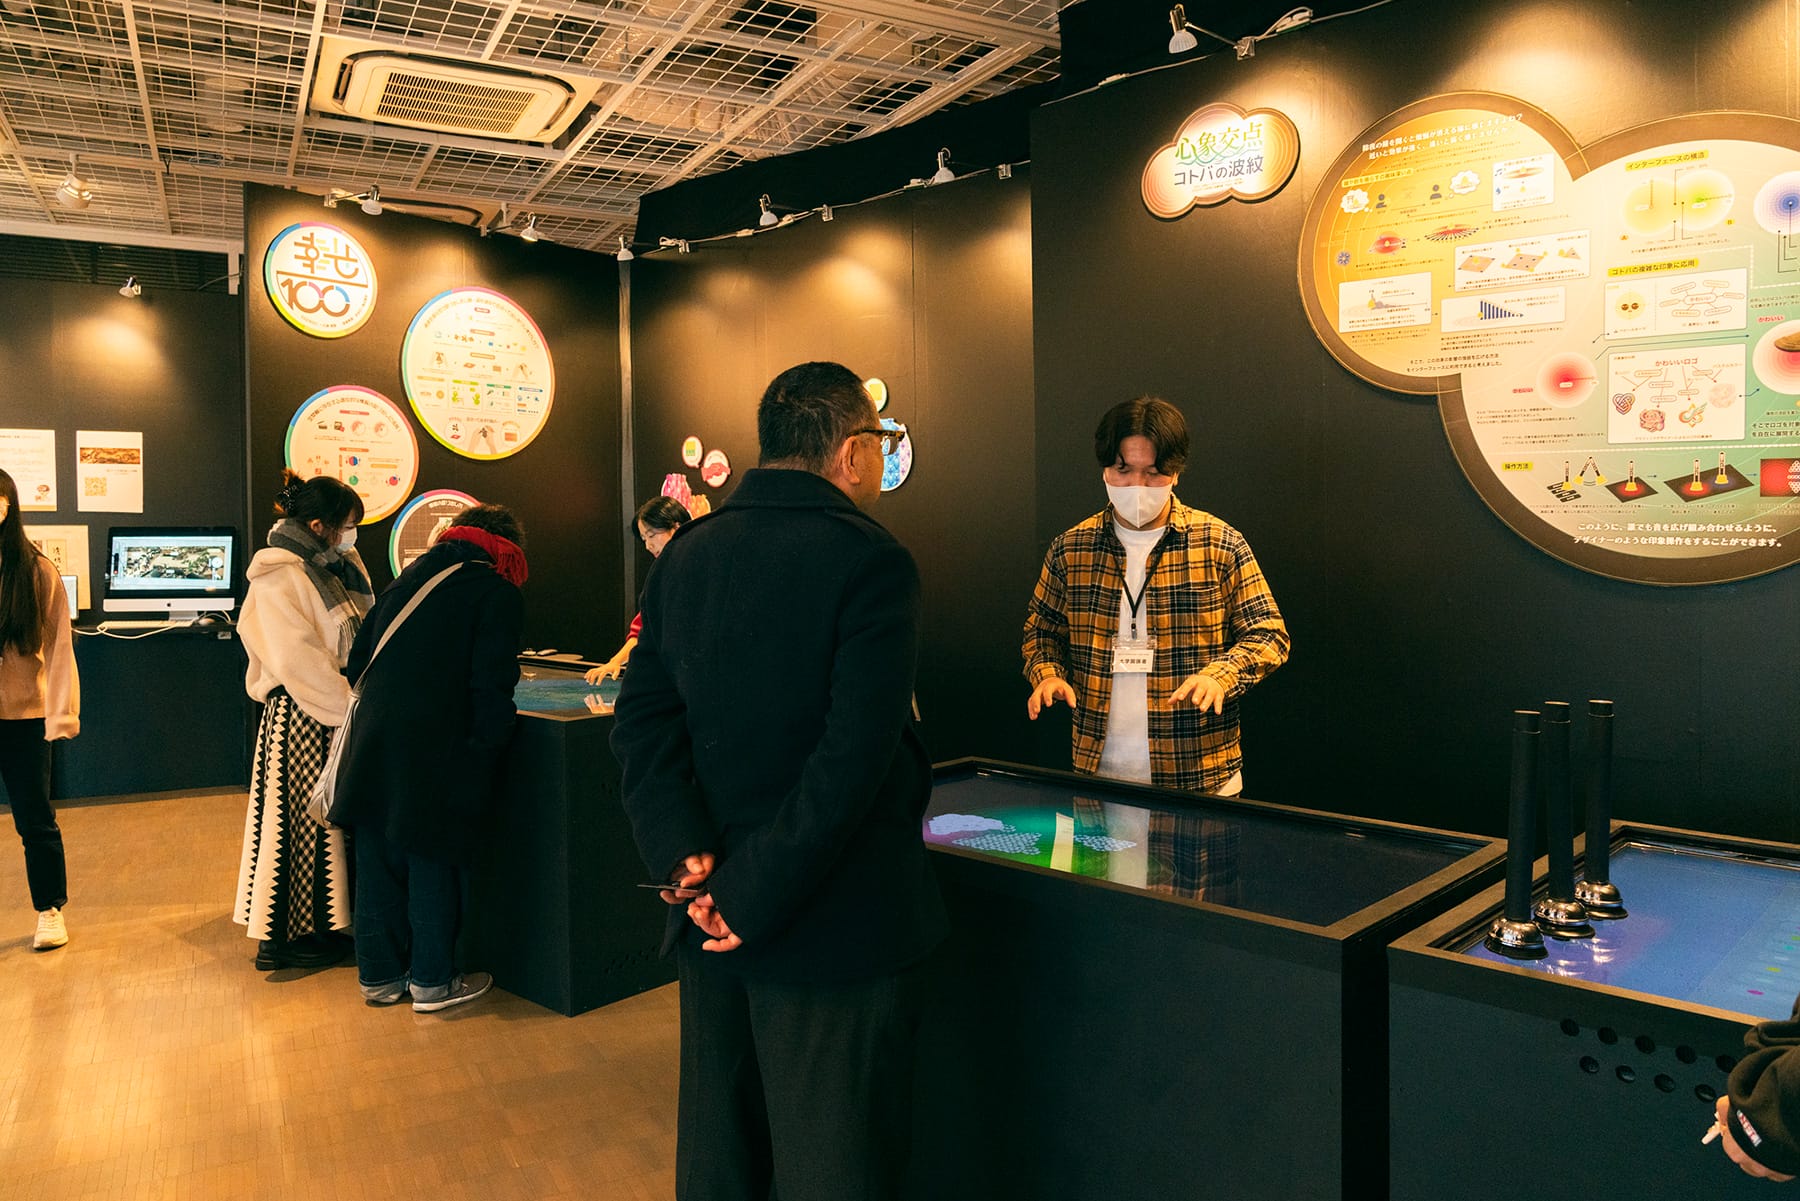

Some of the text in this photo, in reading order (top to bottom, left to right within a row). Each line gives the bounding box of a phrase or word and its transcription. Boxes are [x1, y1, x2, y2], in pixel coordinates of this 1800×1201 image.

[1174, 121, 1262, 161] 心象交点
[1174, 155, 1263, 185] コトバの波紋
[294, 232, 358, 279] 幸せ
[281, 278, 351, 317] 100
